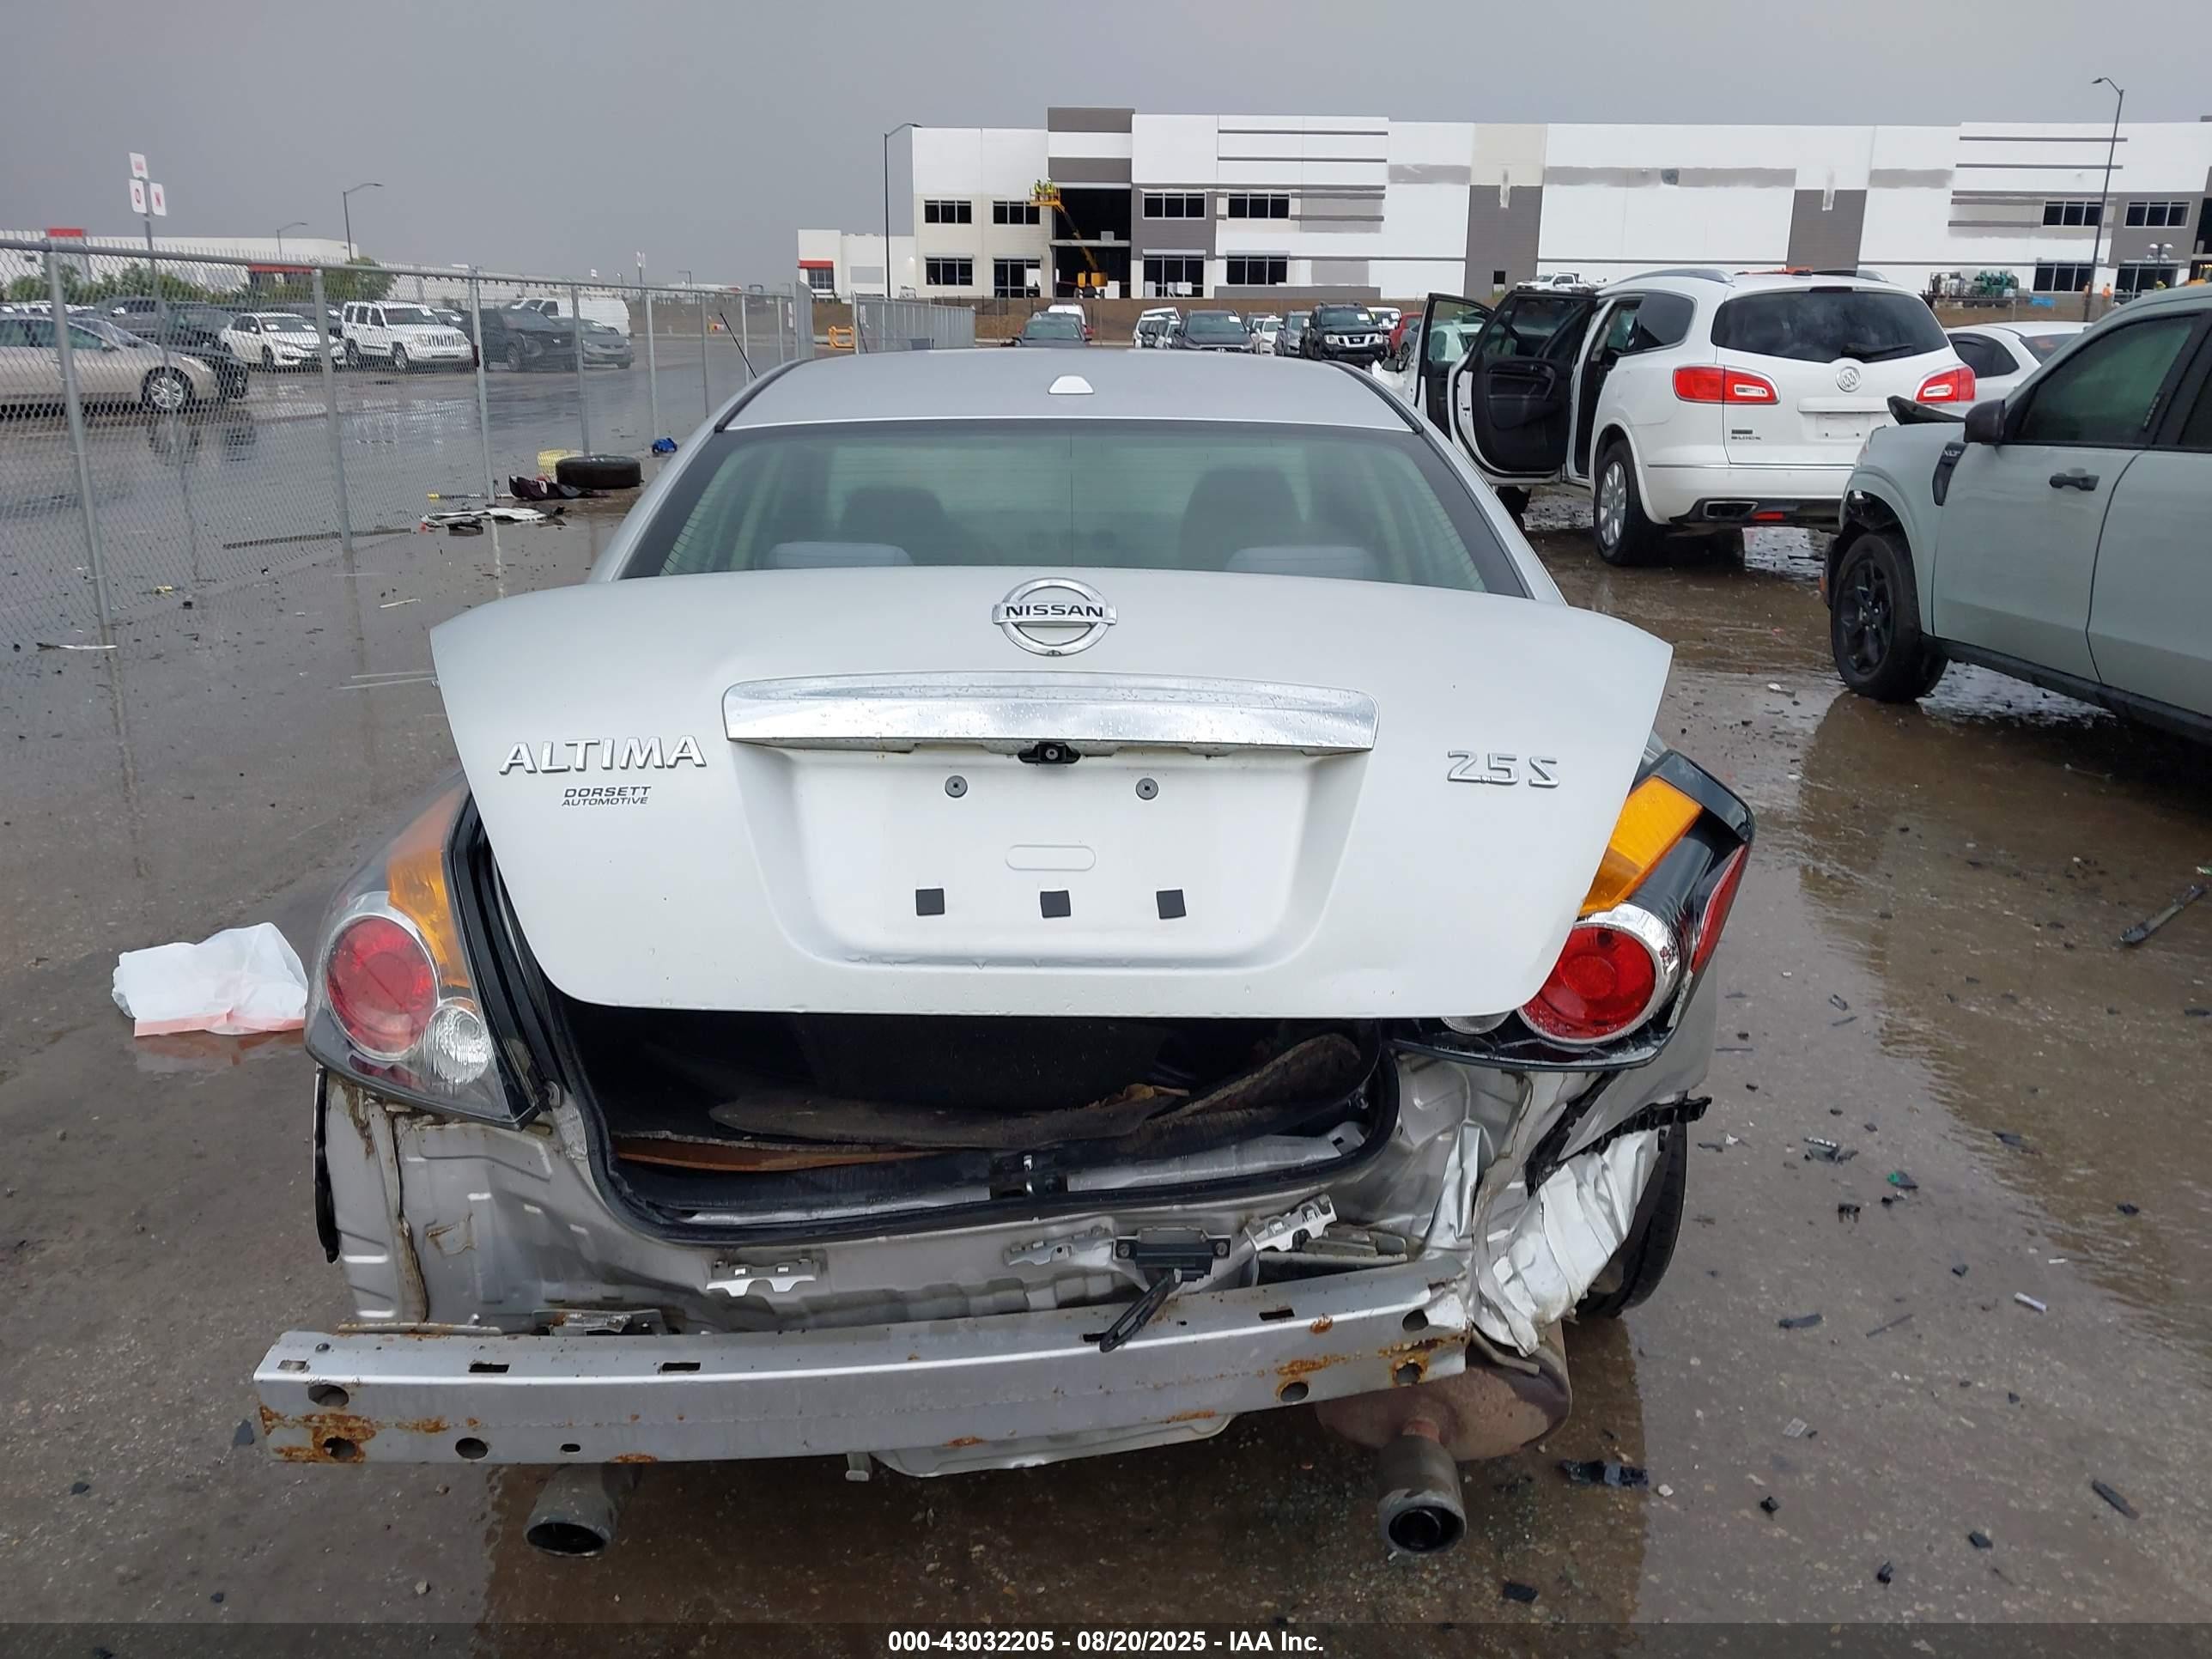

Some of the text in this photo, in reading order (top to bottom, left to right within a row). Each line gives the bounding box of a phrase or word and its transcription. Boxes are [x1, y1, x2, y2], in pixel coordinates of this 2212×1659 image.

[1006, 604, 1103, 617] NISSAN
[499, 735, 707, 775] ALTIMA
[564, 786, 652, 798] DORSETT
[562, 796, 649, 806] AUTOMOTIVE
